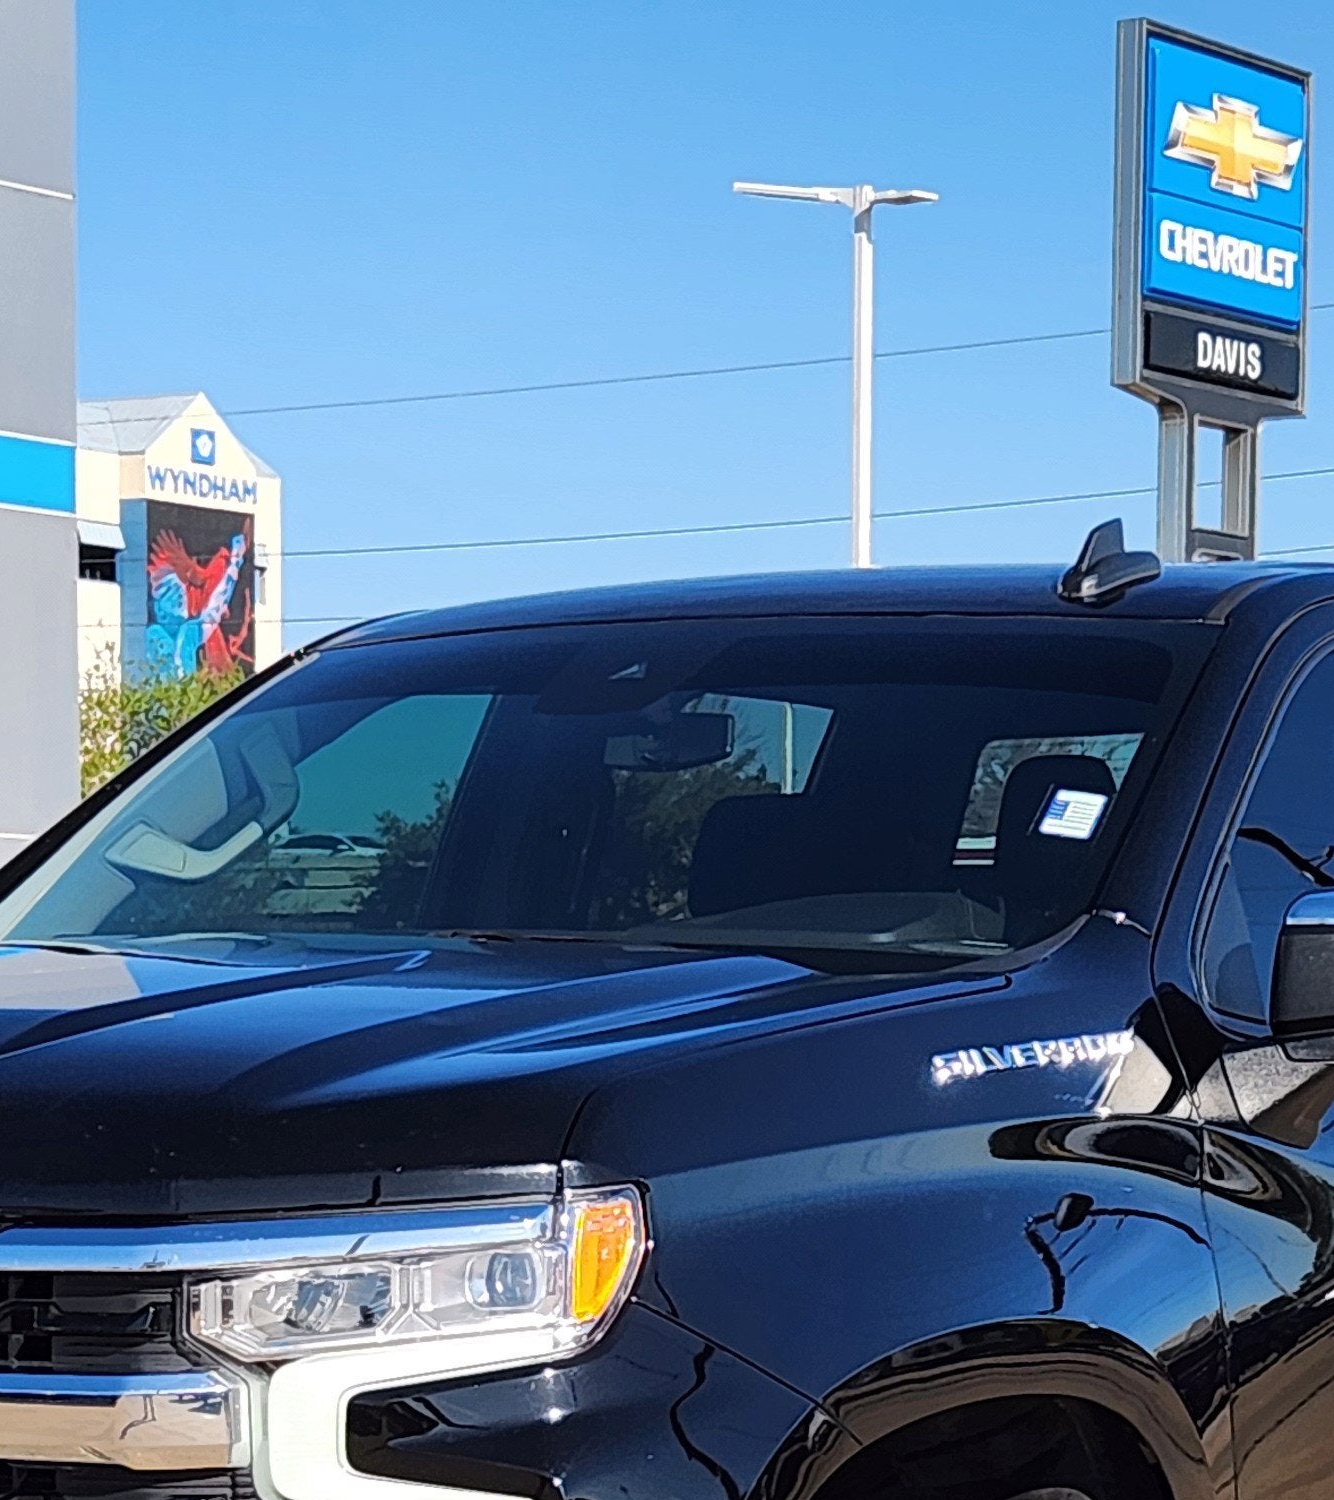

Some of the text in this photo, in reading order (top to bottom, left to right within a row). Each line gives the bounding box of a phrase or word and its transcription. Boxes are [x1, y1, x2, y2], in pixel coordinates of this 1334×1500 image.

[1158, 219, 1298, 290] CHEVROLET
[1196, 331, 1262, 380] DAVIS
[146, 464, 258, 505] WYNDHAM
[931, 1029, 1135, 1086] SILVERADO
